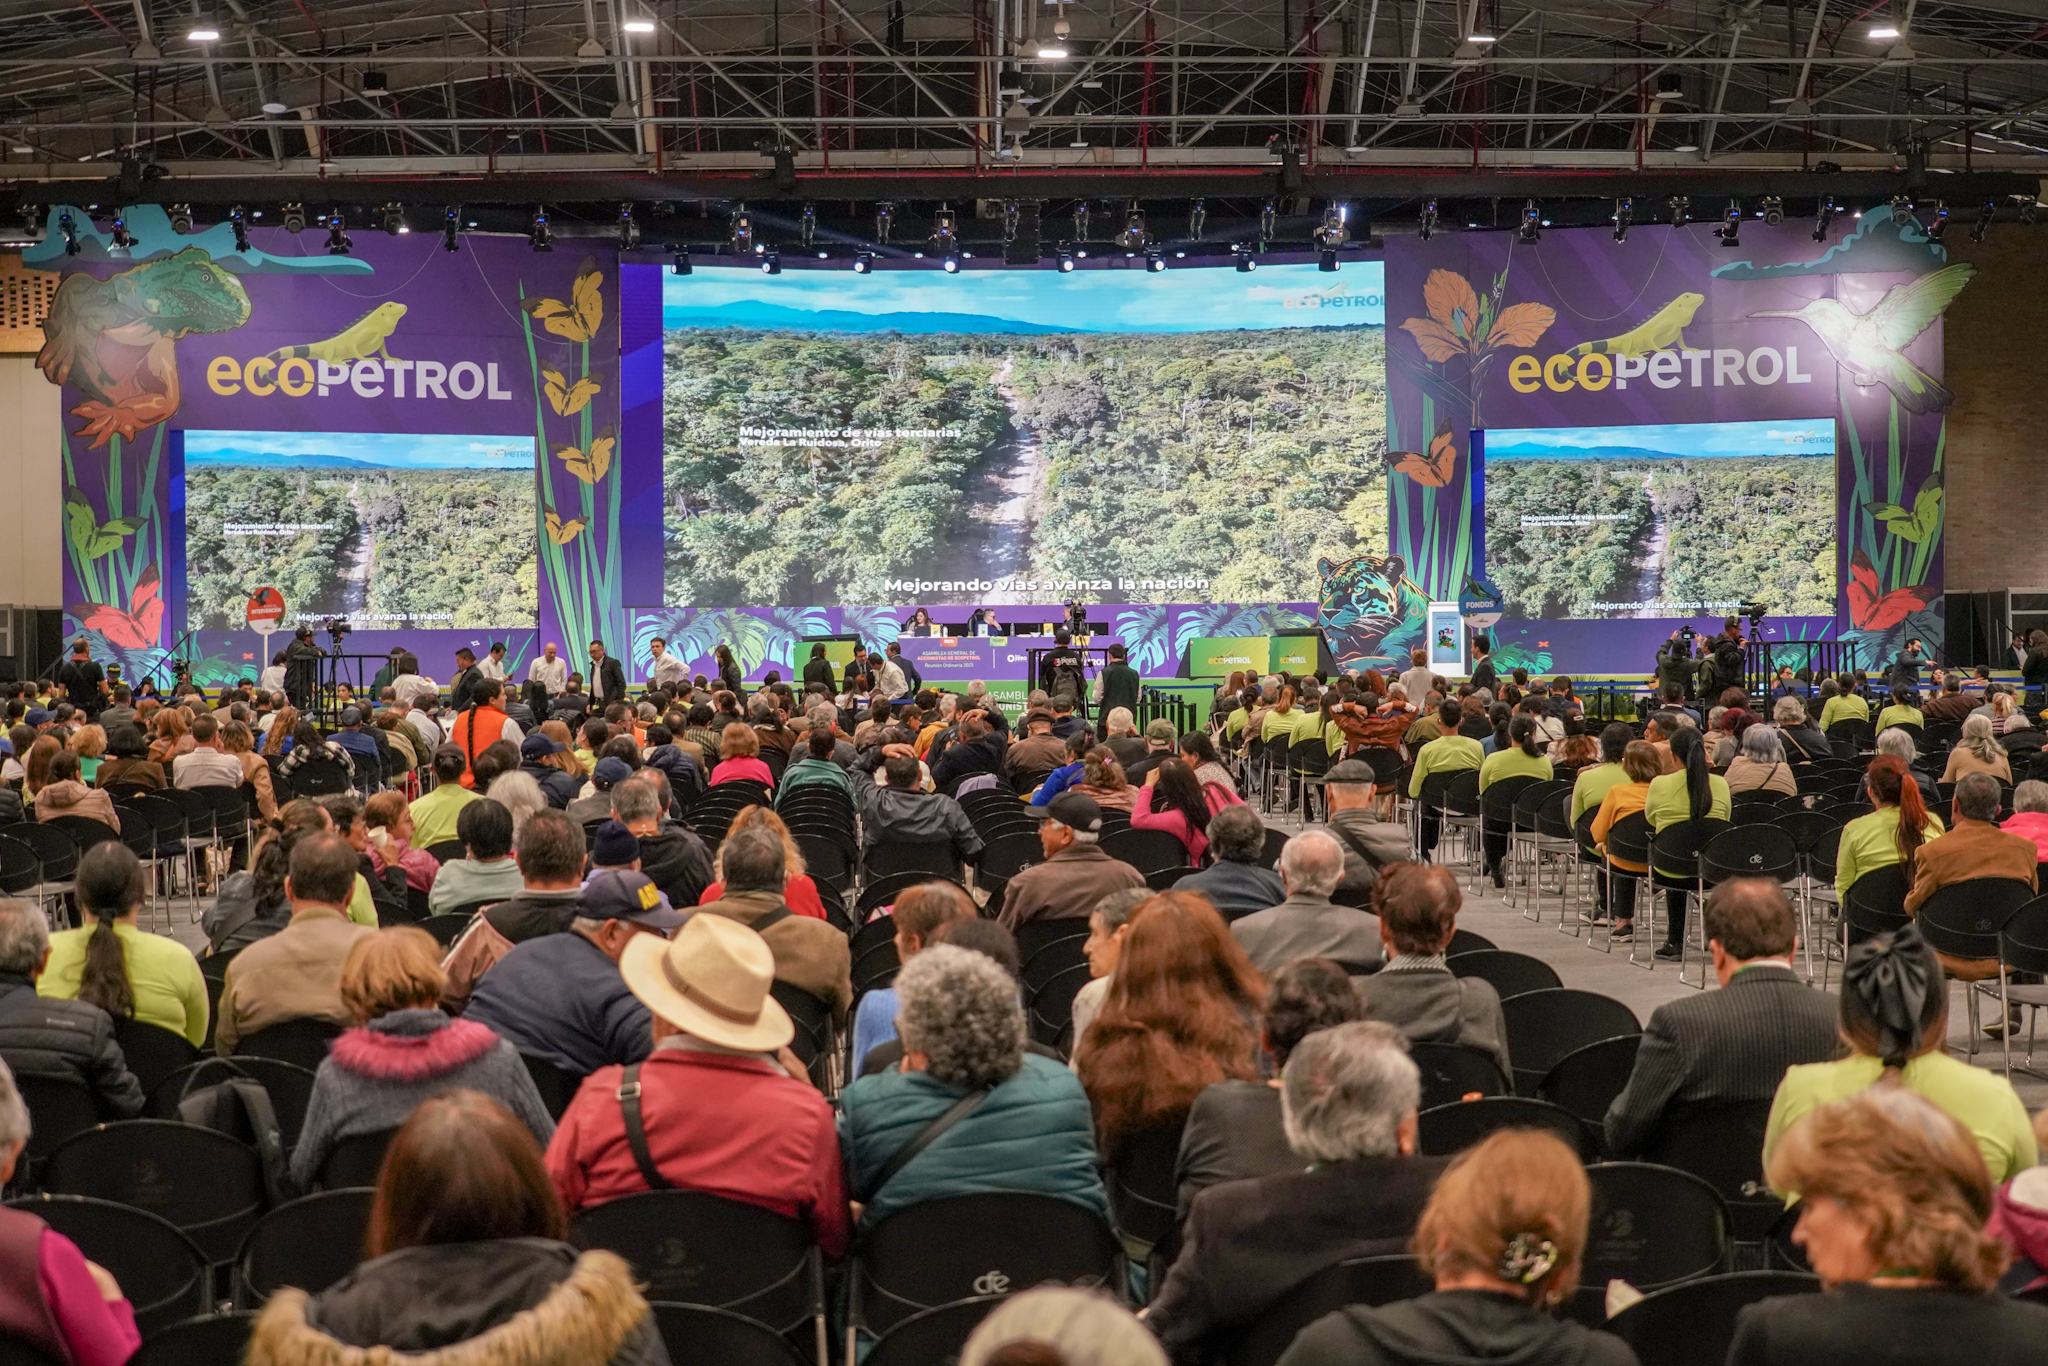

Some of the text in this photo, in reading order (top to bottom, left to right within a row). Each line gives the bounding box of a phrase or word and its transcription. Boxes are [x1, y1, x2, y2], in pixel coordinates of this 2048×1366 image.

[740, 427, 961, 439] Mejoramiento de vías terciarias
[740, 438, 780, 447] Vereda
[783, 438, 797, 447] La
[851, 438, 882, 447] Orito
[224, 523, 274, 531] Mejoramiento
[885, 576, 1209, 595] Mejorando vías avanza la nación
[1465, 601, 1494, 609] FONDOS
[1591, 602, 1643, 611] Mejorando
[1645, 601, 1665, 609] vías
[1715, 600, 1748, 608] nació
[409, 612, 418, 620] la
[421, 611, 453, 620] nación
